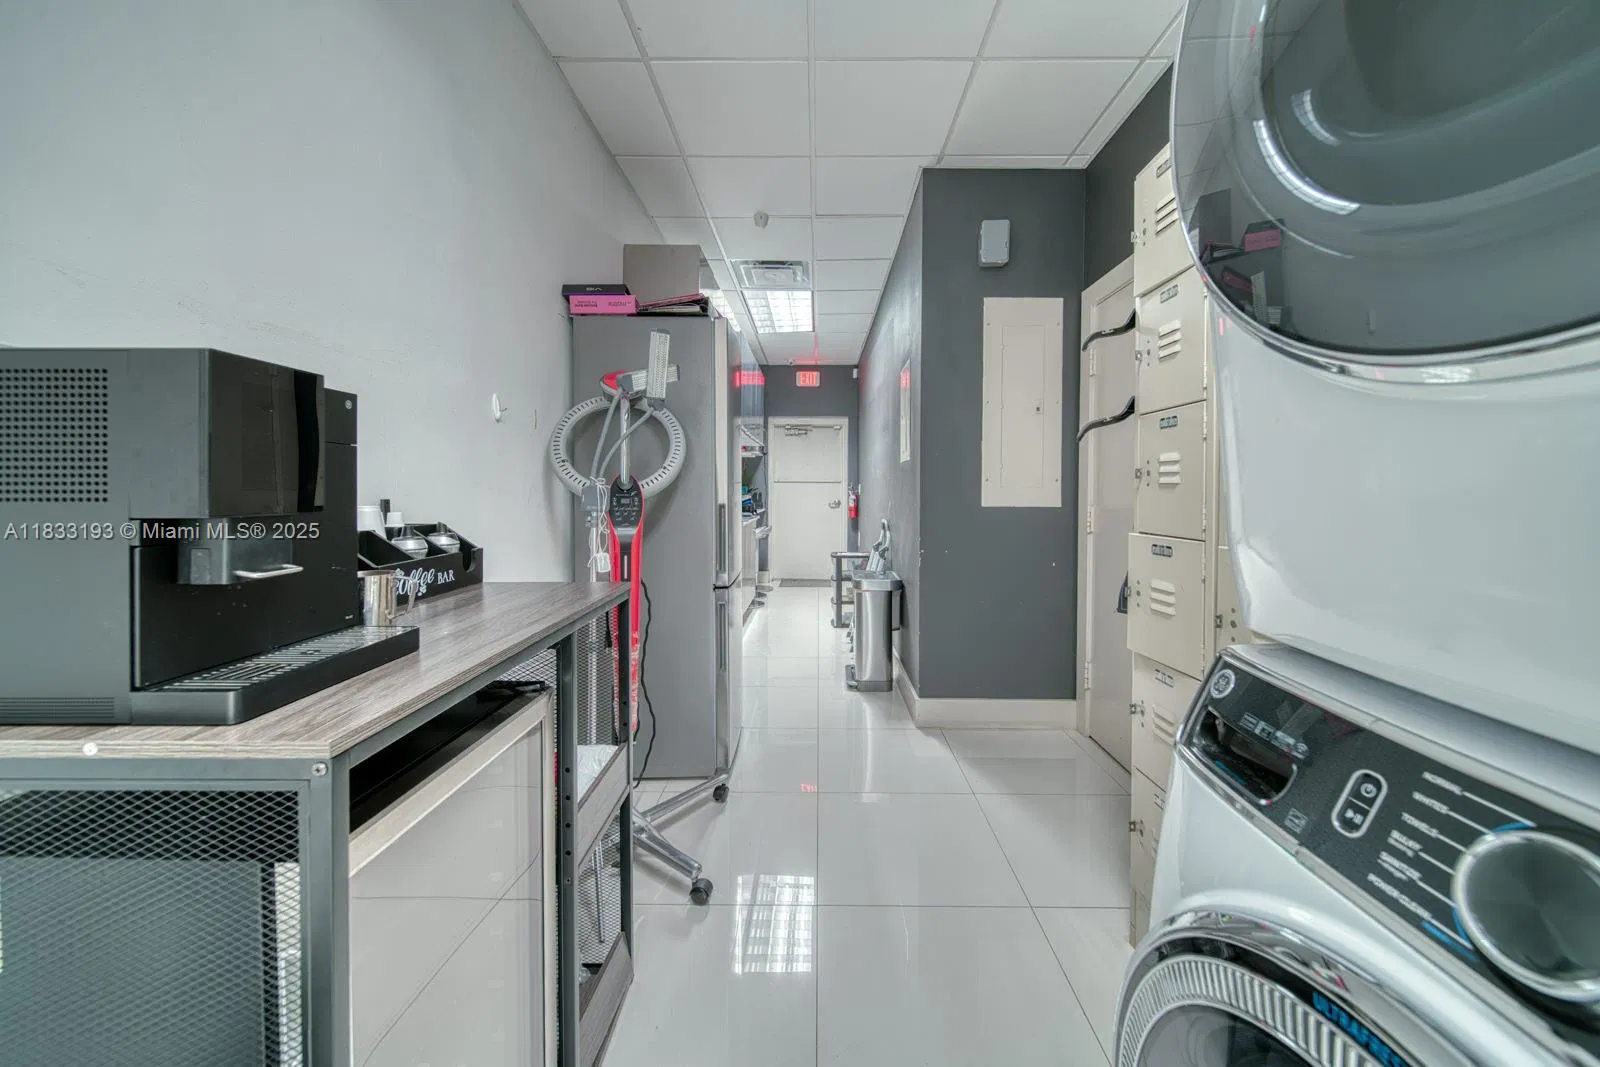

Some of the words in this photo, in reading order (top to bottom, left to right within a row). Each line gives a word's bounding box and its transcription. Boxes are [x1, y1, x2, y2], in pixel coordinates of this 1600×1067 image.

[799, 371, 817, 385] EXIT
[395, 567, 435, 596] offee
[437, 569, 455, 585] BAR
